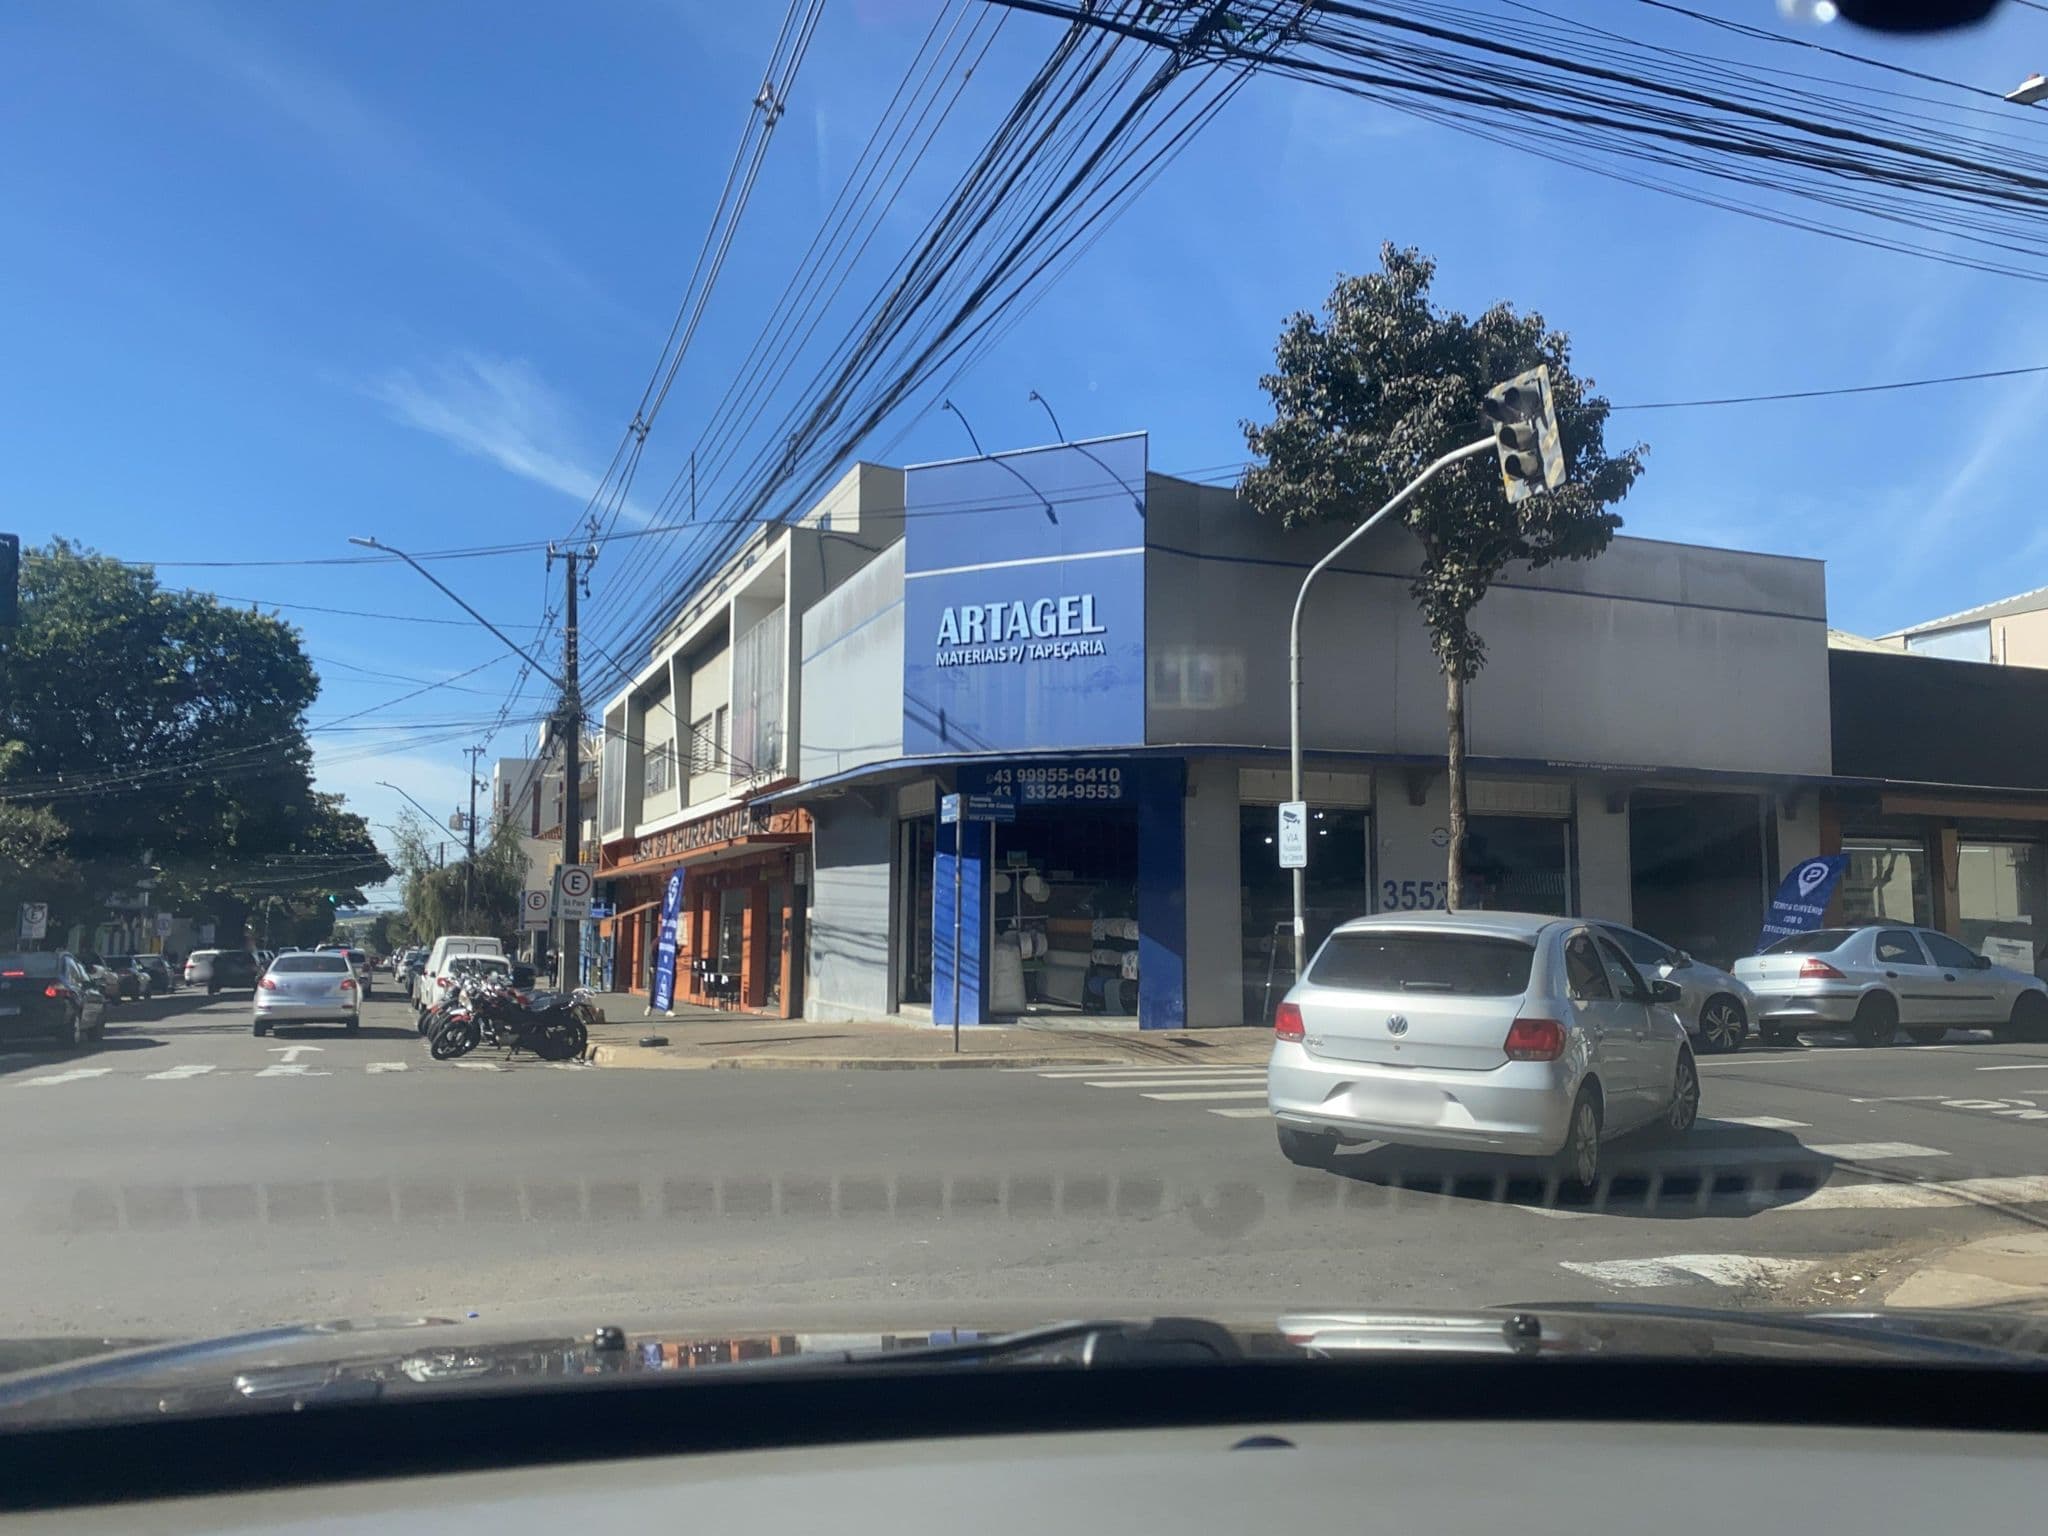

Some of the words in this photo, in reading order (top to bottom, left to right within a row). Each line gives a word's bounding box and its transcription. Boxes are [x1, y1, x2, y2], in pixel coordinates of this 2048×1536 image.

[936, 593, 1106, 647] ARTAGEL
[936, 649, 1007, 668] MATERIAIS
[1010, 644, 1024, 664] P/
[1029, 639, 1106, 661] TAPEÇARIA
[994, 770, 1012, 784] 43
[1017, 768, 1121, 783] 99955-6410
[1026, 784, 1121, 799] 3324-9553
[571, 875, 582, 890] E
[533, 895, 541, 906] E
